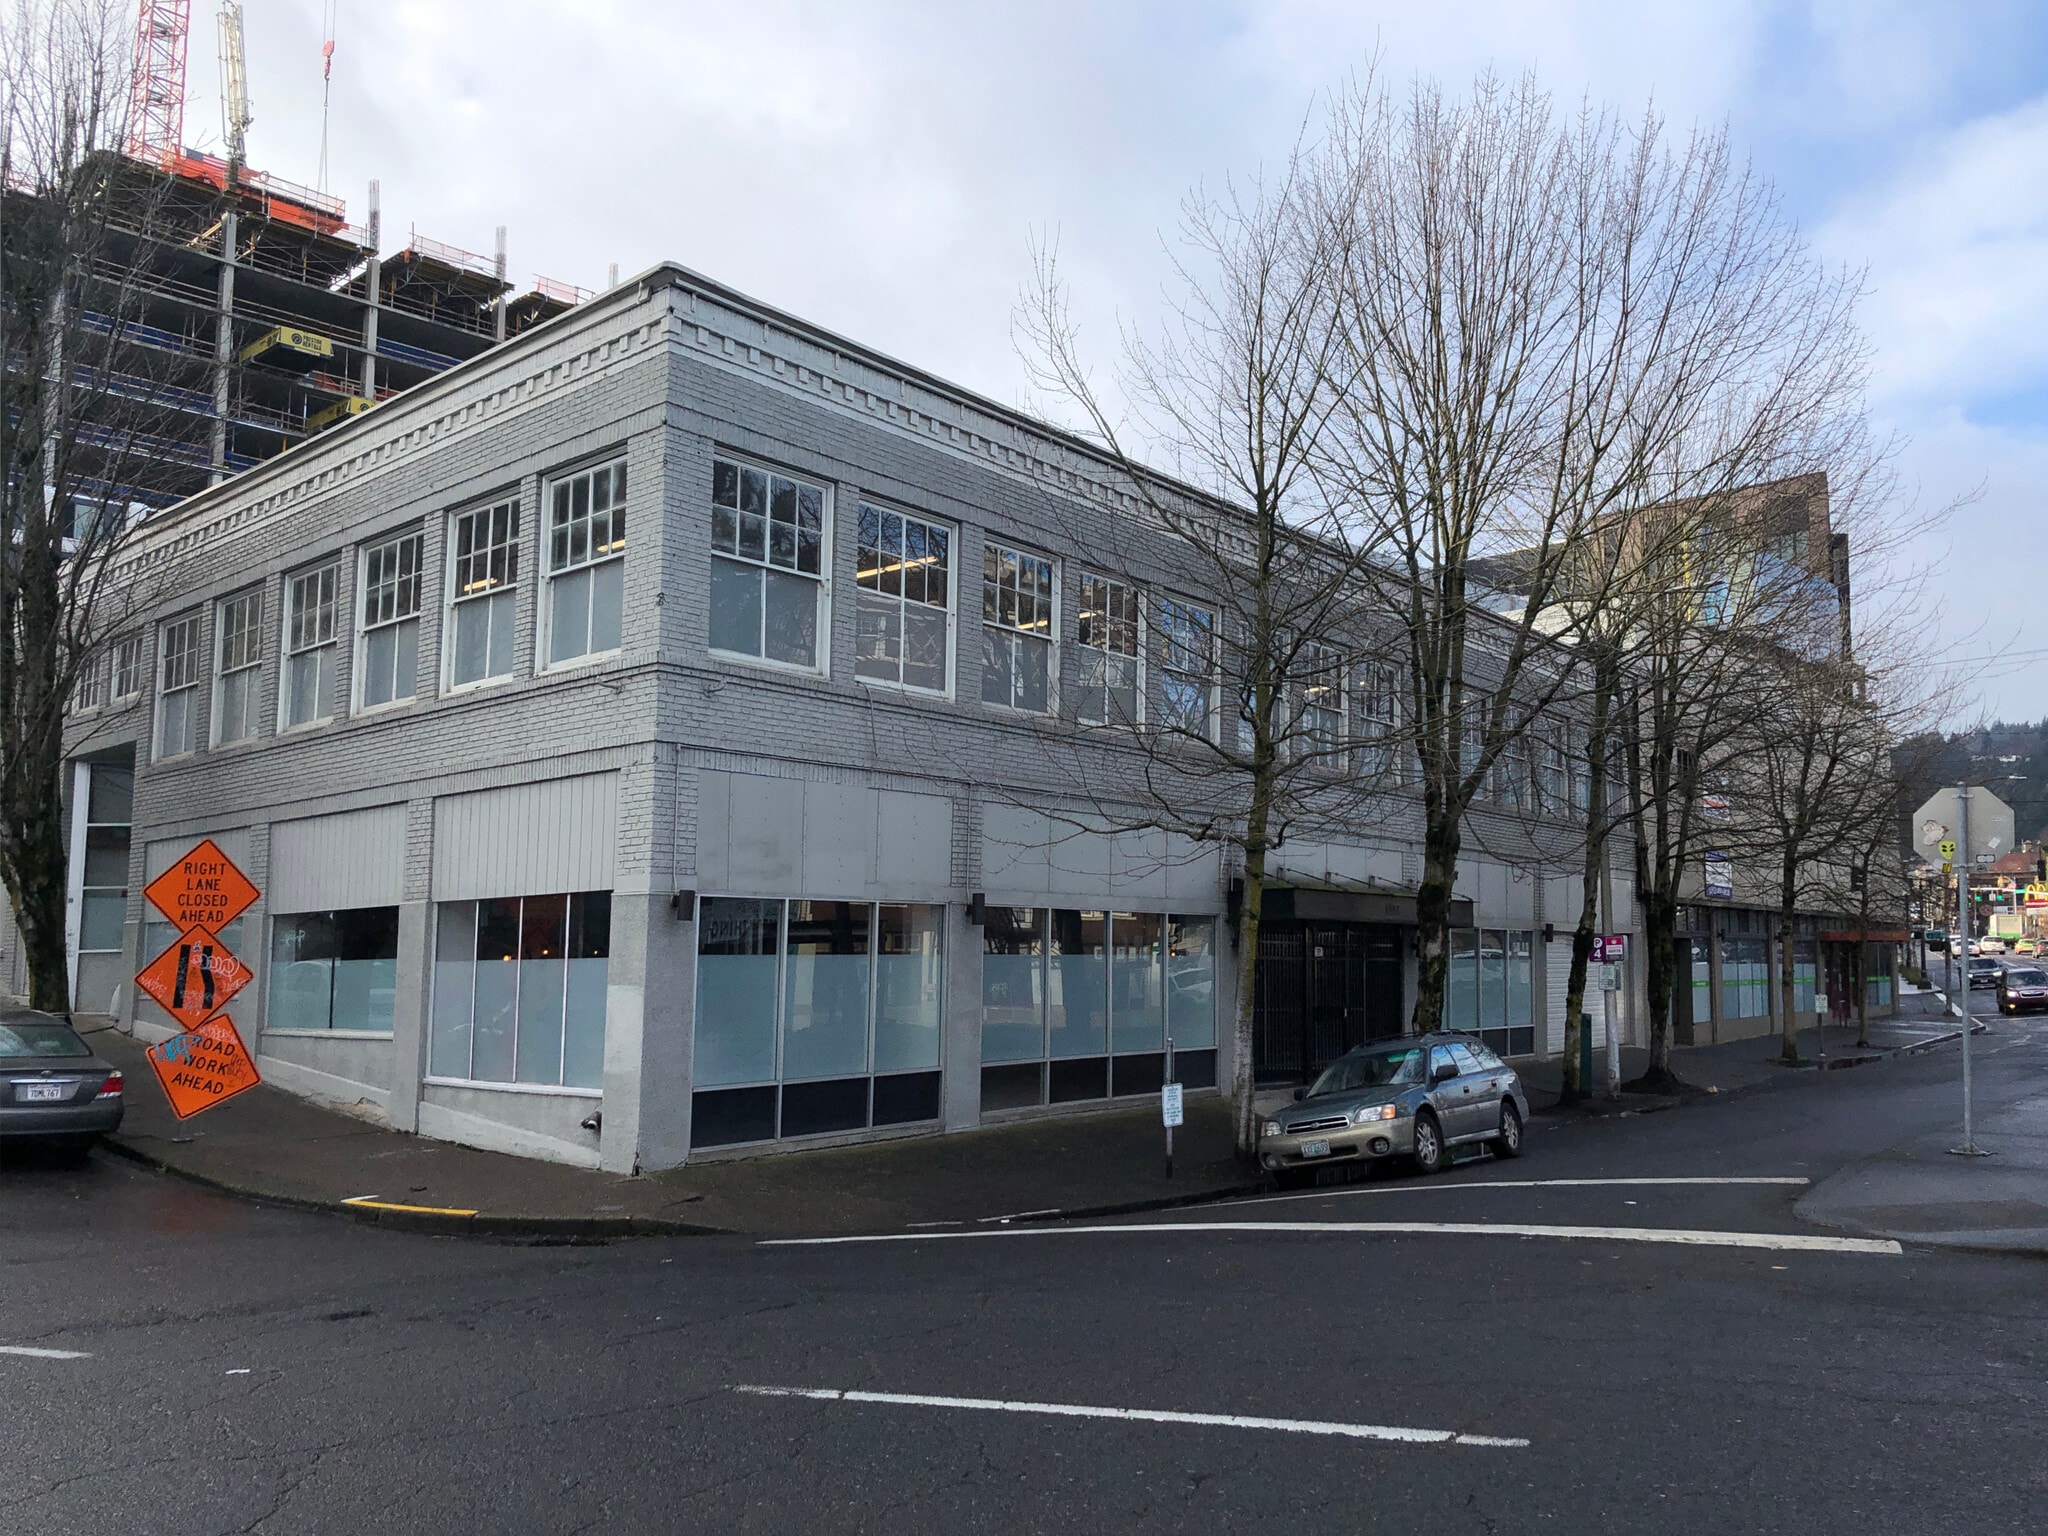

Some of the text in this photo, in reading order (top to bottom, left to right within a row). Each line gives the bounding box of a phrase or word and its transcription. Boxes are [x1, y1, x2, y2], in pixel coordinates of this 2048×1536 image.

[183, 862, 227, 876] RIGHT
[186, 878, 221, 891] LANE
[177, 893, 228, 907] CLOSED
[179, 909, 224, 922] AHEAD
[1594, 949, 1601, 958] 4
[183, 1054, 229, 1076] WORK
[171, 1072, 224, 1095] AHEAD
